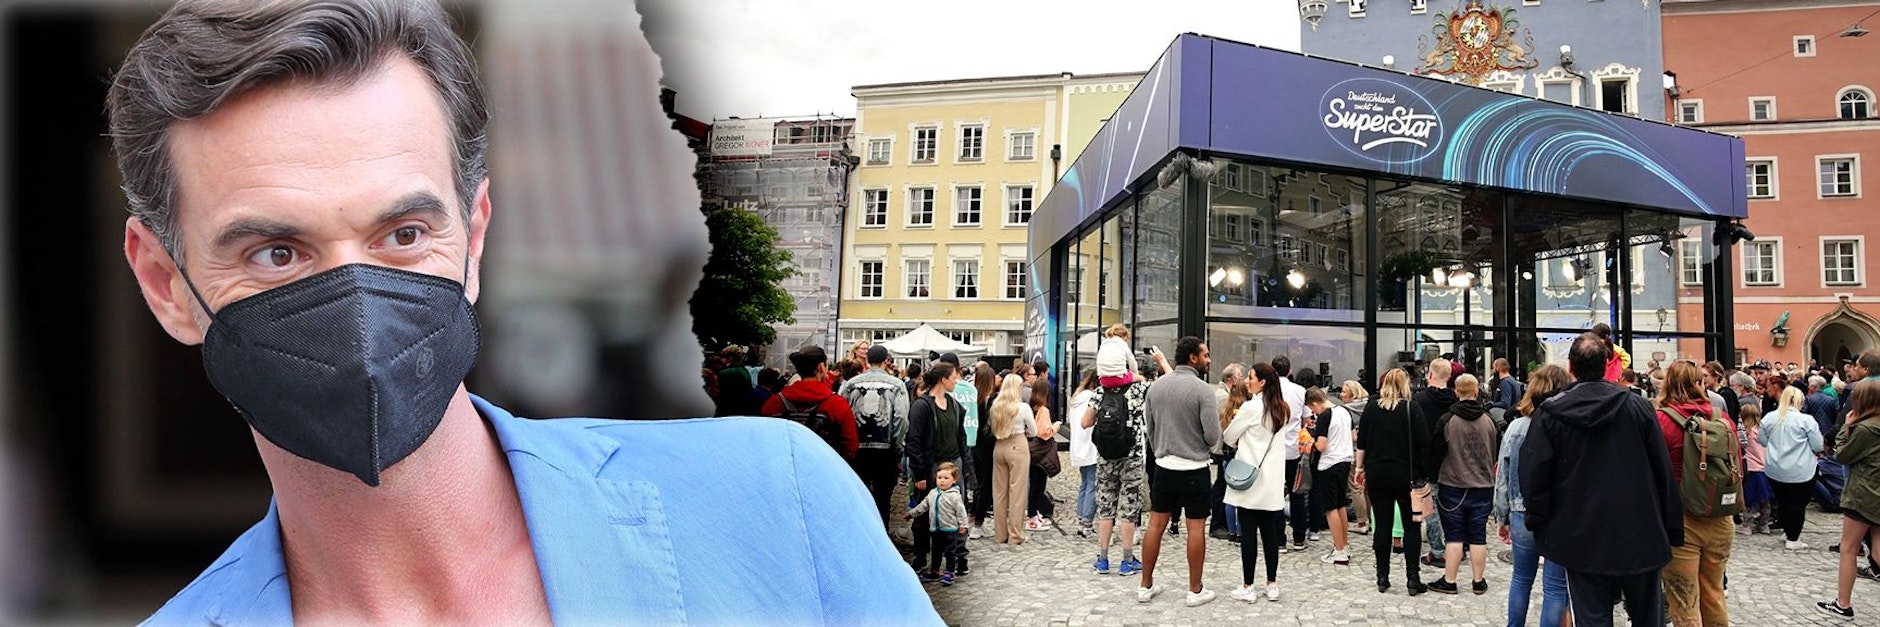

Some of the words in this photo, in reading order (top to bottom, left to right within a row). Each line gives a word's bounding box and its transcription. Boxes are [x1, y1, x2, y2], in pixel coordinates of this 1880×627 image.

[1347, 90, 1396, 104] Deutschland
[1324, 98, 1437, 144] SuperStar
[714, 142, 745, 150] GREGOR
